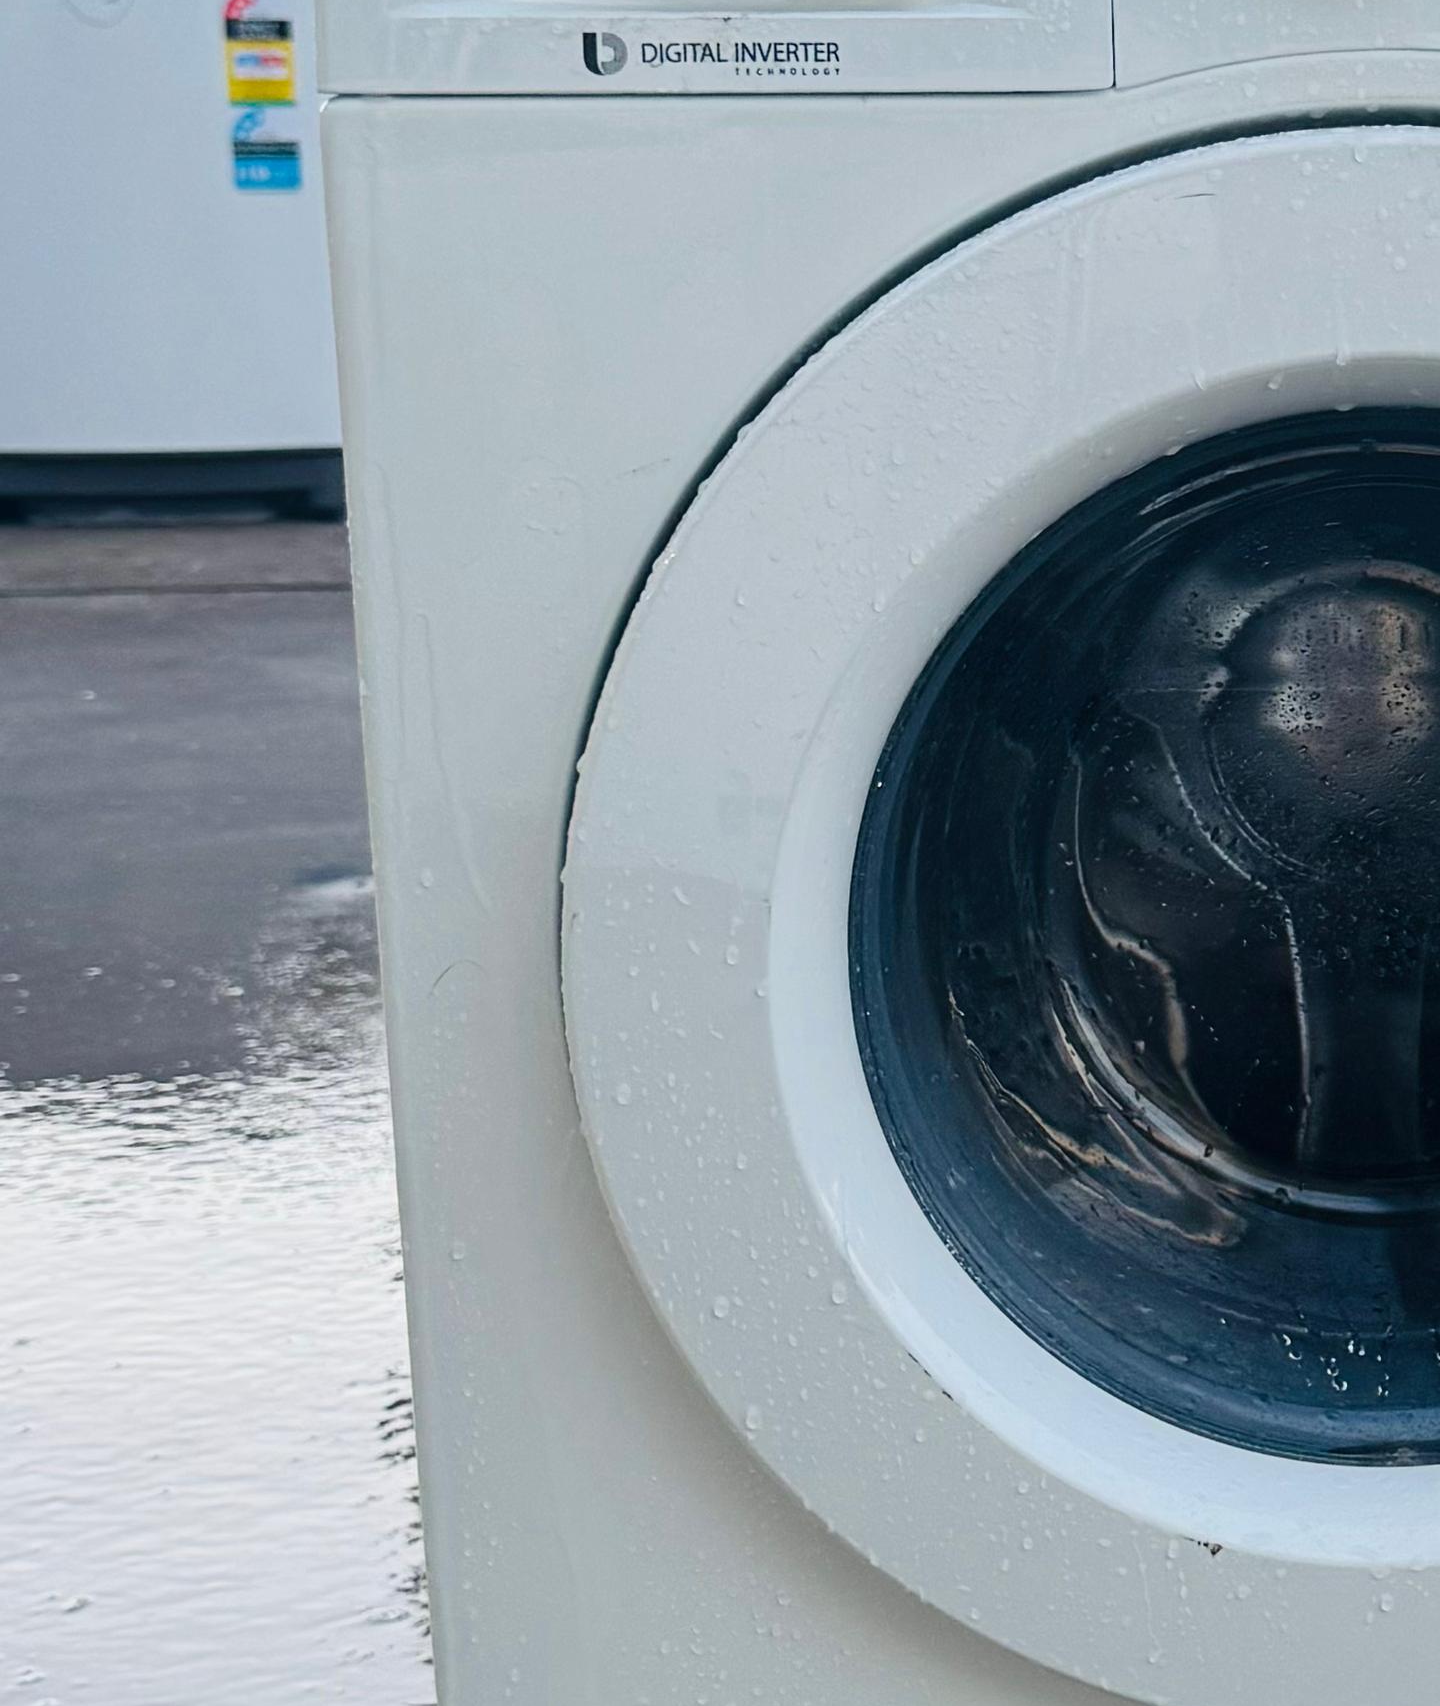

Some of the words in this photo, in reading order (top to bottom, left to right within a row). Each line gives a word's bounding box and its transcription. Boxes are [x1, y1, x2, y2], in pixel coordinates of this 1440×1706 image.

[641, 42, 728, 64] DIGITAL
[735, 42, 840, 63] INVERTER
[735, 67, 841, 76] TECHNOLOGY
